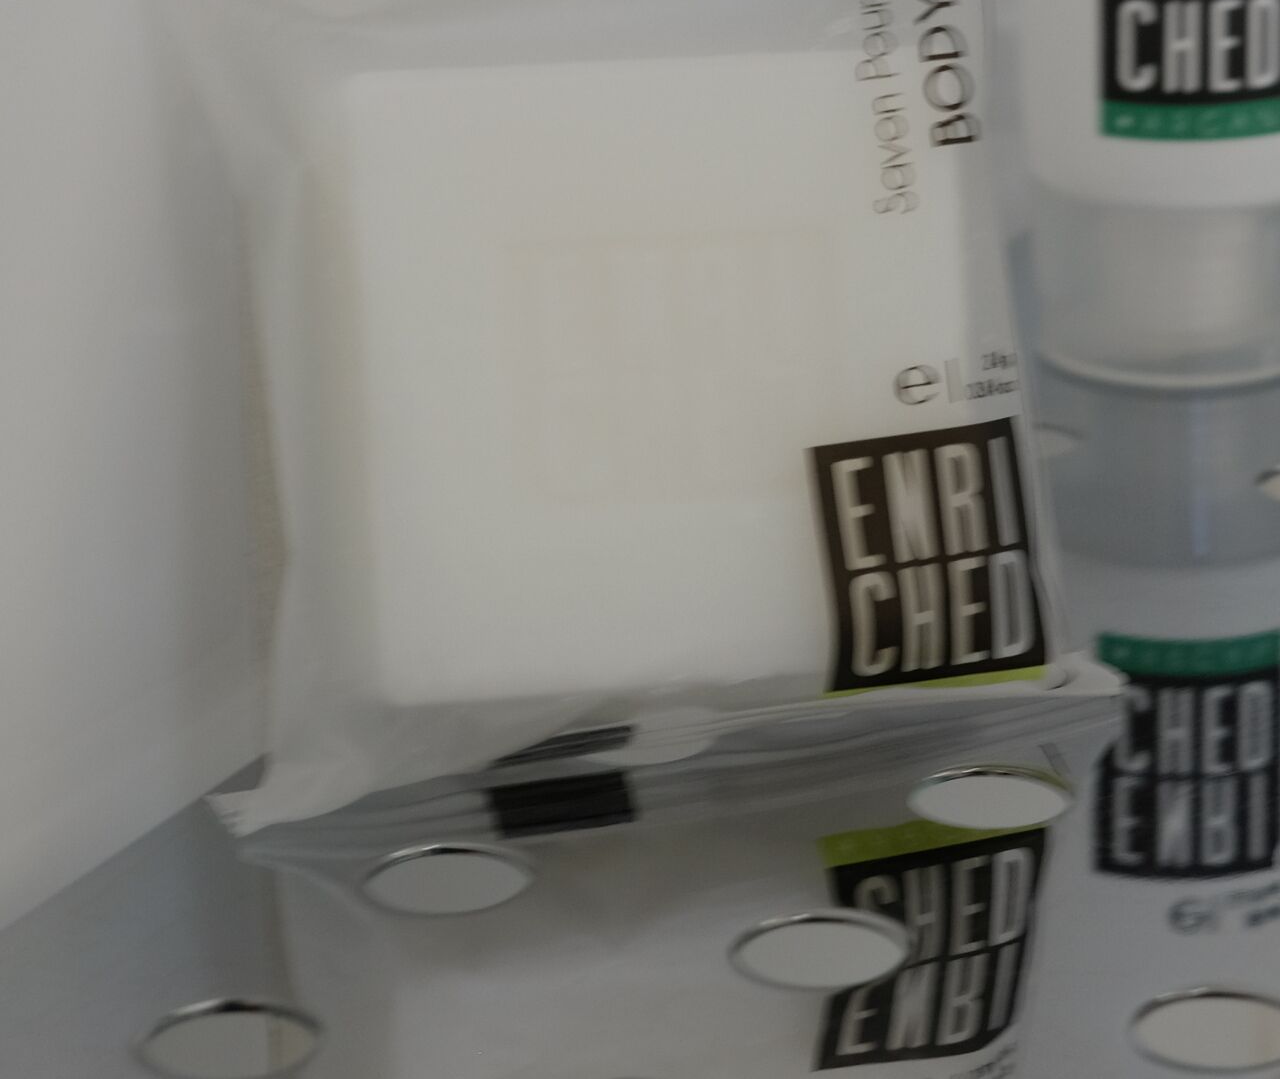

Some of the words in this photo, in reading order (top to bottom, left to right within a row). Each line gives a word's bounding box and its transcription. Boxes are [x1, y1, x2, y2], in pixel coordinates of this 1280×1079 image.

[854, 0, 902, 82] Pour
[871, 92, 919, 215] Savon
[830, 435, 1021, 571] ENRI
[848, 548, 1036, 677] CHED
